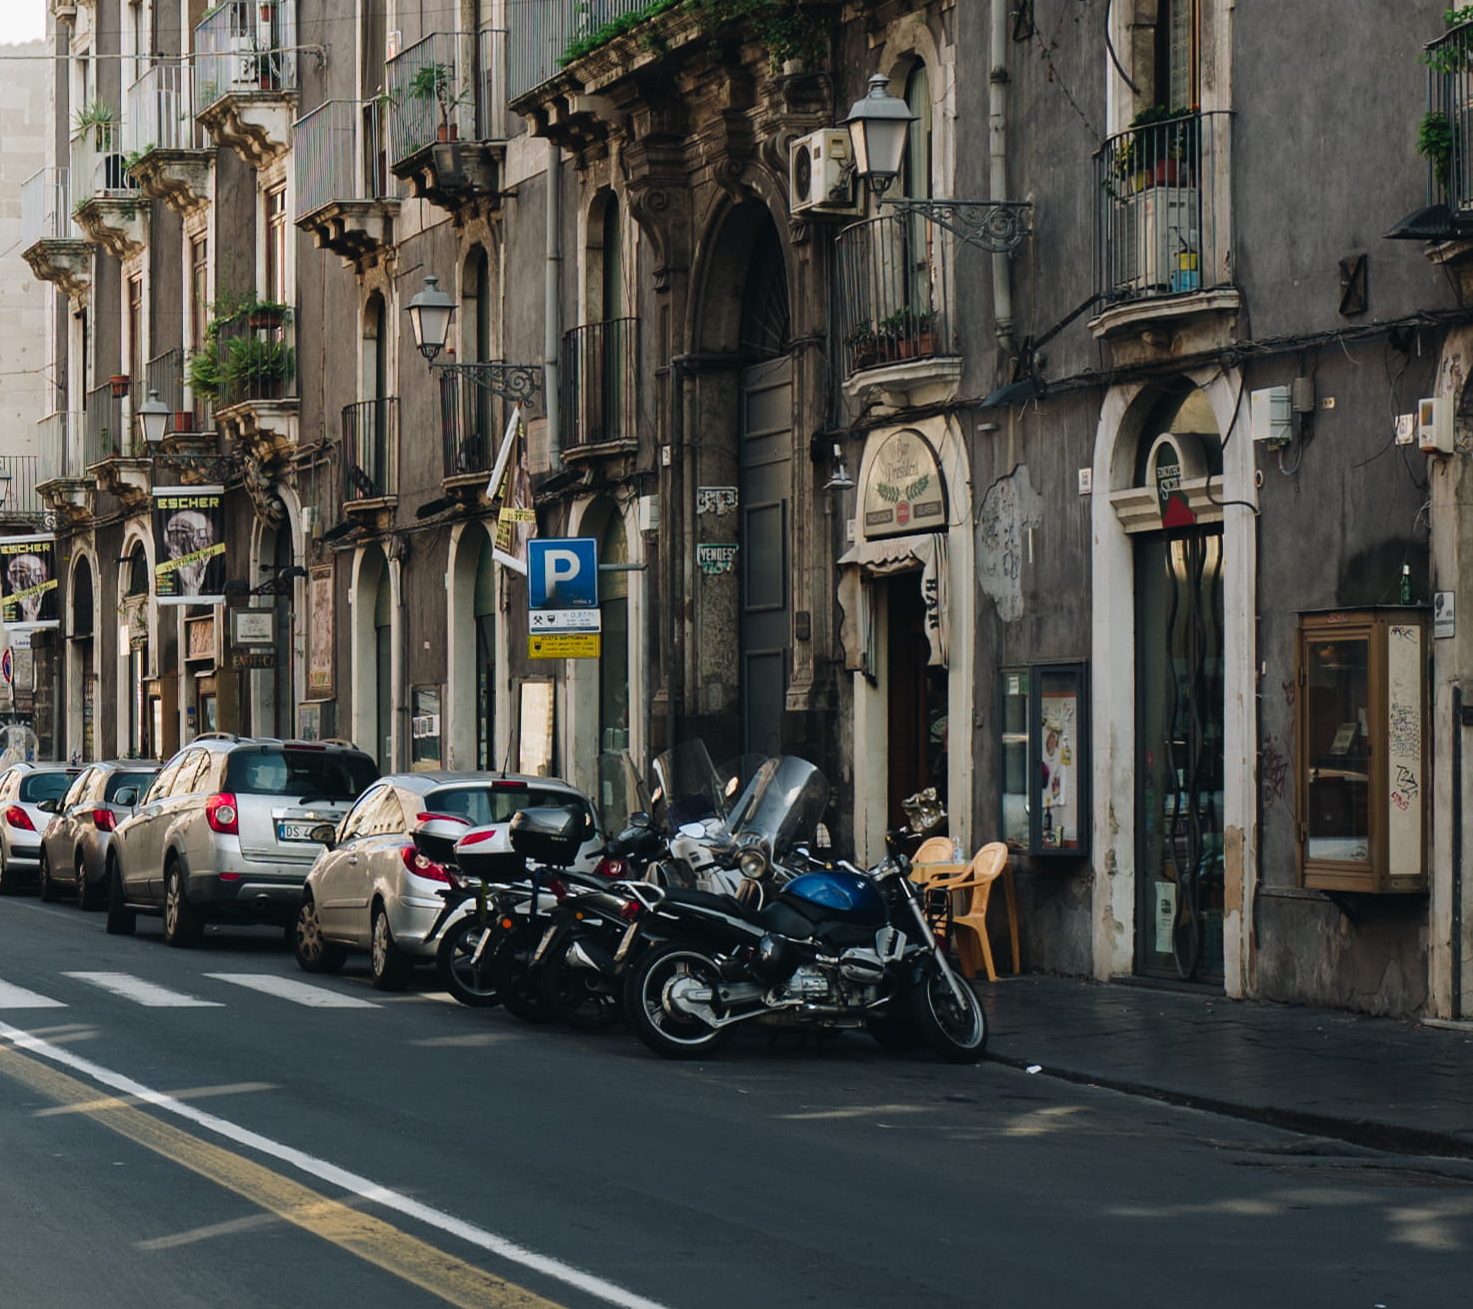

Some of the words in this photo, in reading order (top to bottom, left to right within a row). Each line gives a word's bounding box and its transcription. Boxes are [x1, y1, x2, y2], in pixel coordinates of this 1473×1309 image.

[157, 497, 220, 509] ESCHER
[1, 543, 51, 554] ESCHER
[700, 547, 735, 561] VENDES
[544, 549, 581, 600] P
[926, 579, 940, 629] BAR
[286, 826, 300, 838] DS
